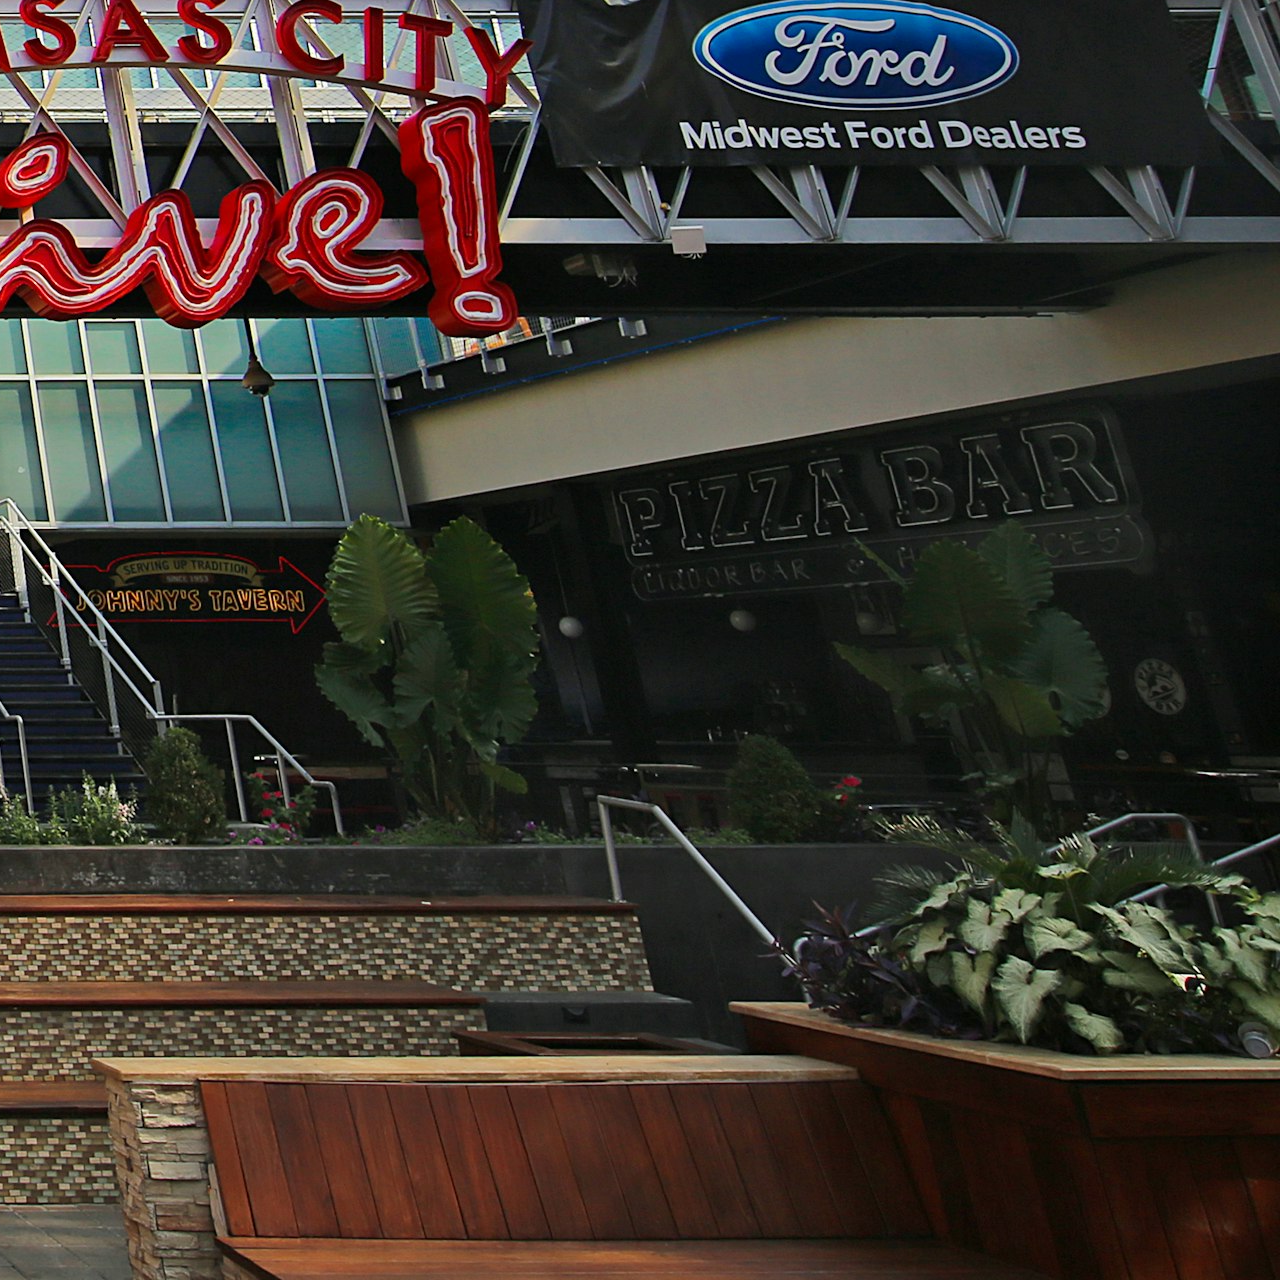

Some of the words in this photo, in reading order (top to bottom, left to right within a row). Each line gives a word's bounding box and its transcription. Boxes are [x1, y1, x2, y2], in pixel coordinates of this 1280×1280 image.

[765, 15, 955, 87] Ford
[679, 119, 841, 150] Midwest
[845, 120, 935, 150] Ford
[938, 120, 1087, 150] Dealers
[620, 458, 869, 558] PIZZA
[881, 422, 1119, 528] BAR
[122, 560, 170, 575] SERVING
[173, 559, 188, 570] UP
[192, 560, 249, 575] TRADITION
[642, 566, 743, 593] LIQUOR
[749, 557, 811, 585] BAR
[76, 589, 202, 613] JOHNNY'S
[208, 589, 306, 613] TAVERN
